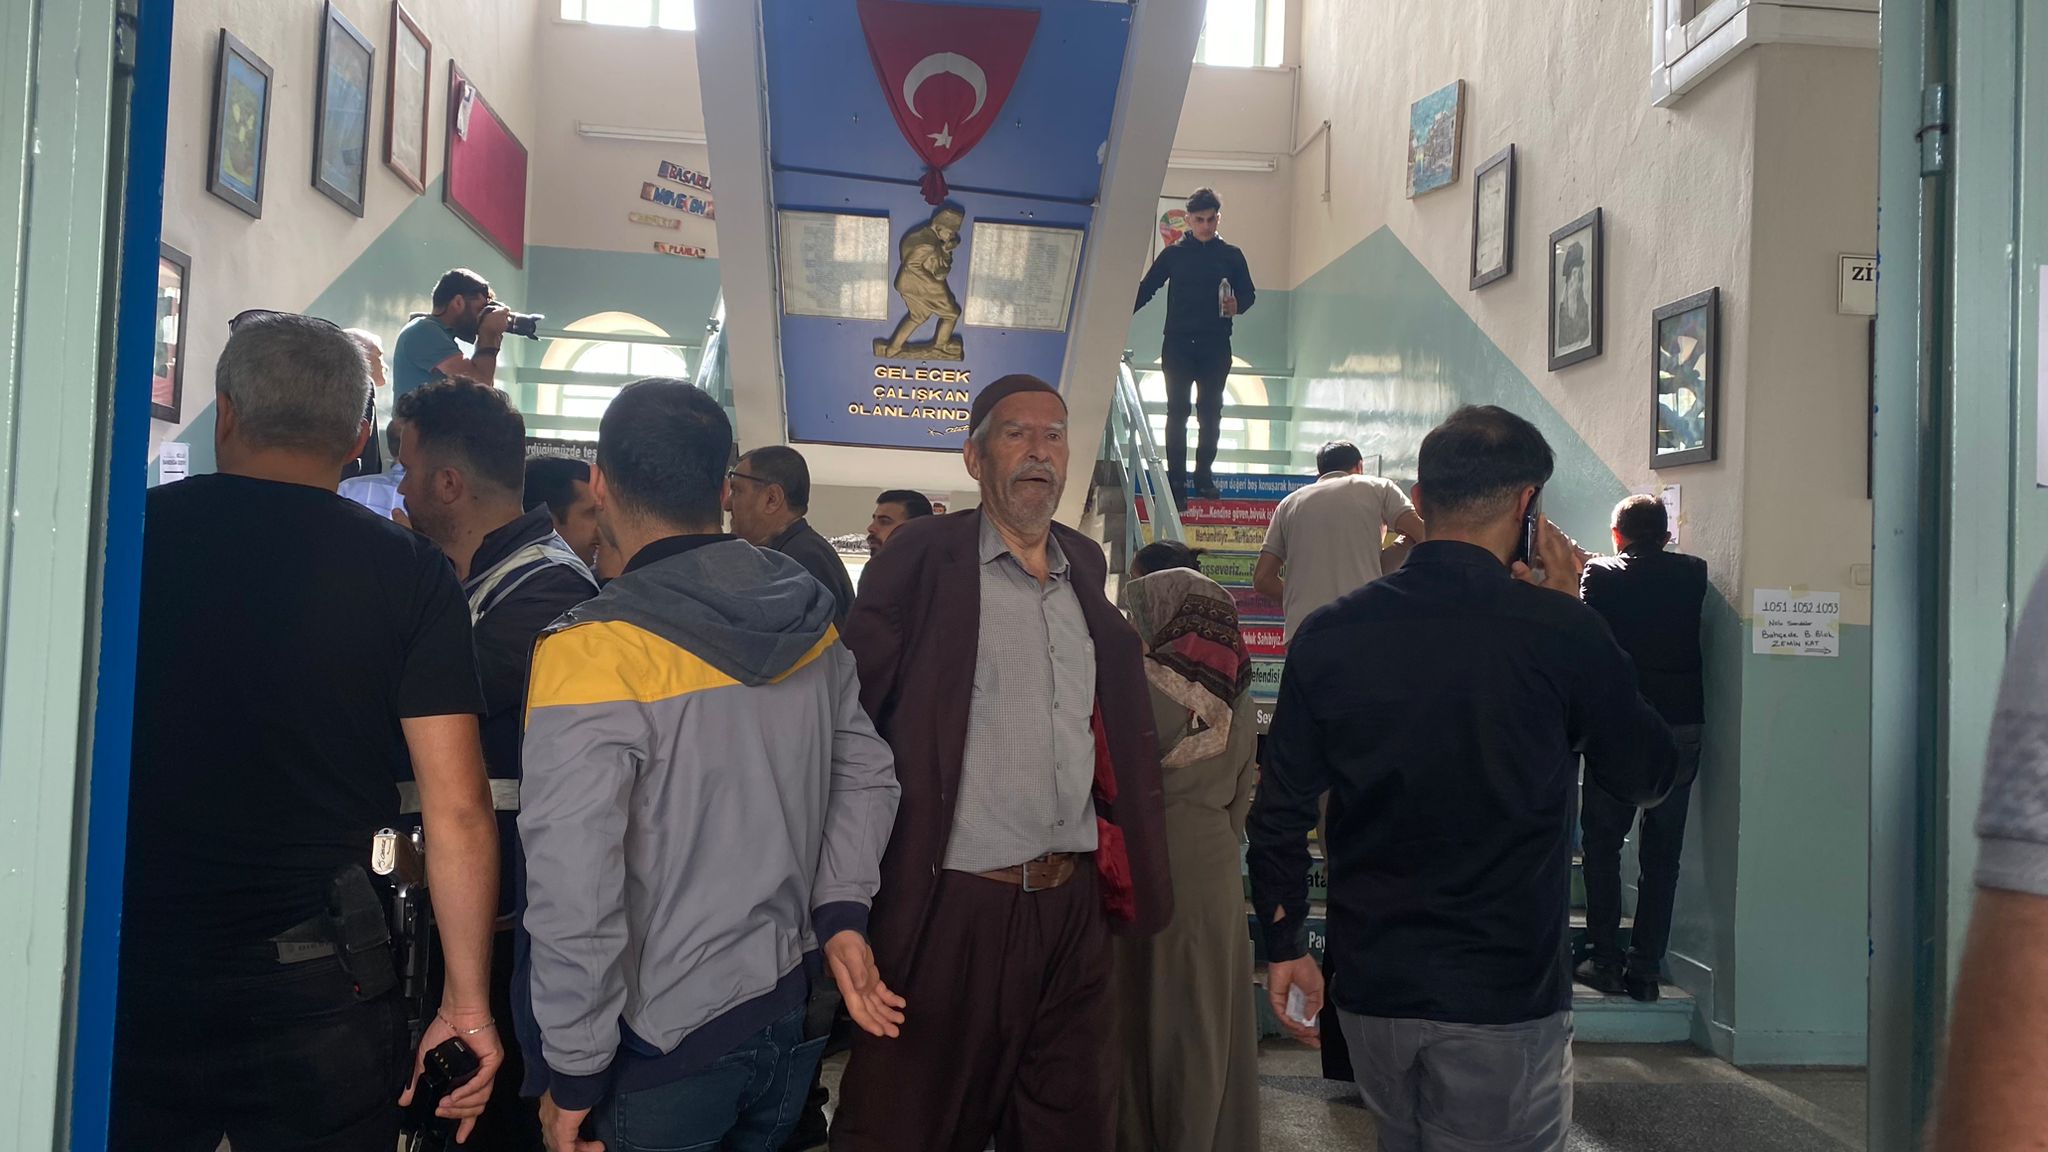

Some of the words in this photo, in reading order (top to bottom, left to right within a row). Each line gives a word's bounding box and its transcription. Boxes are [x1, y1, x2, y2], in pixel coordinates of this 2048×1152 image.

[653, 187, 687, 210] MOVE
[1852, 262, 1876, 282] Zİ
[874, 364, 971, 384] GELECEK
[873, 384, 969, 404] ÇALIŞKAN
[848, 402, 971, 421] OLANLARIND
[1761, 601, 1787, 613] 1051
[1792, 602, 1814, 614] 1052
[1815, 602, 1839, 614] 1053
[1251, 667, 1280, 684] efendisi
[1256, 709, 1274, 725] Sev
[1308, 931, 1326, 953] Pay
